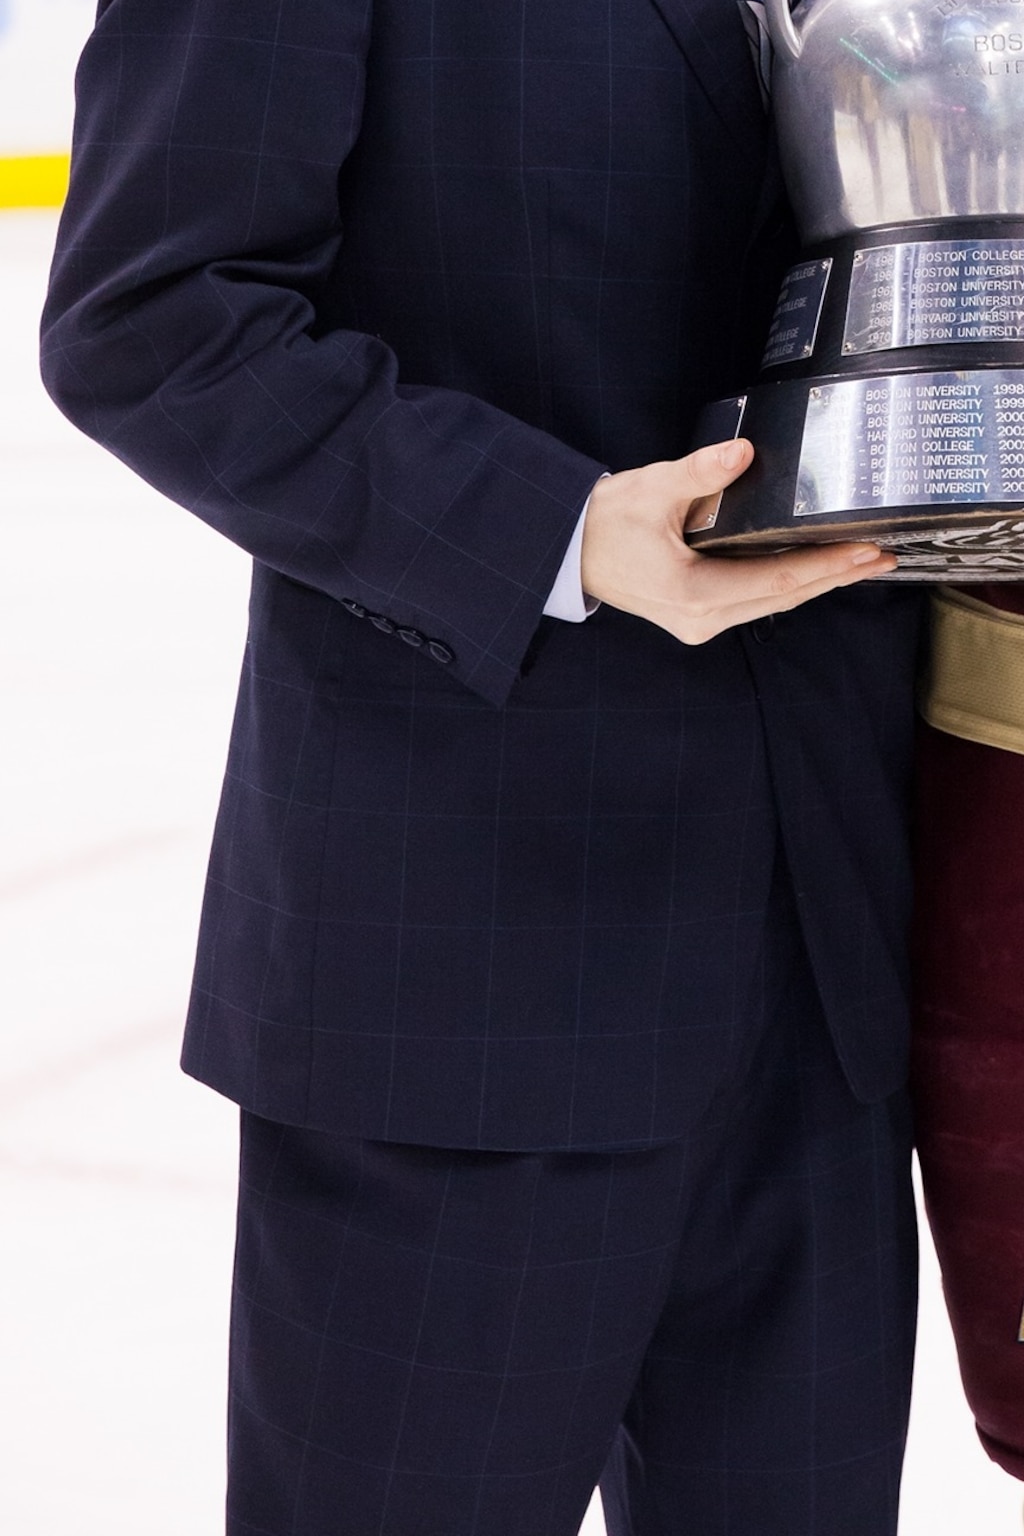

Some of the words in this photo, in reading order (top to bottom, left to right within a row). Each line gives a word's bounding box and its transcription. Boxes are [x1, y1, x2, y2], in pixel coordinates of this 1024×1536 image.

[919, 251, 967, 263] BOSTON
[913, 266, 959, 279] BOSTON
[911, 281, 957, 294] BOSTON
[910, 297, 956, 310] BOSTON
[908, 312, 957, 325] HARVARD
[960, 310, 1024, 323] UNIVERSITY
[906, 328, 953, 341] BOSTON
[957, 326, 1022, 339] UNIVERSITY
[865, 387, 911, 402] BOSON
[915, 383, 982, 398] UNIVERSITY
[992, 383, 1024, 396] 1998
[865, 401, 912, 415] BOSON
[916, 398, 983, 412] UNIVERSITY
[867, 414, 914, 429] BOSON
[918, 411, 985, 426] UNIVERSITY
[921, 425, 986, 439] UNIVERSITY
[870, 441, 917, 456] BOTON
[921, 439, 974, 452] COLLEGE
[870, 455, 917, 469] BOTON
[921, 453, 988, 468] UNIVERSITY
[871, 469, 918, 483] BOSTON
[923, 467, 989, 482] UNIVERSITY
[871, 483, 919, 497] BOSTON
[923, 481, 991, 495] UNIVERSITY
